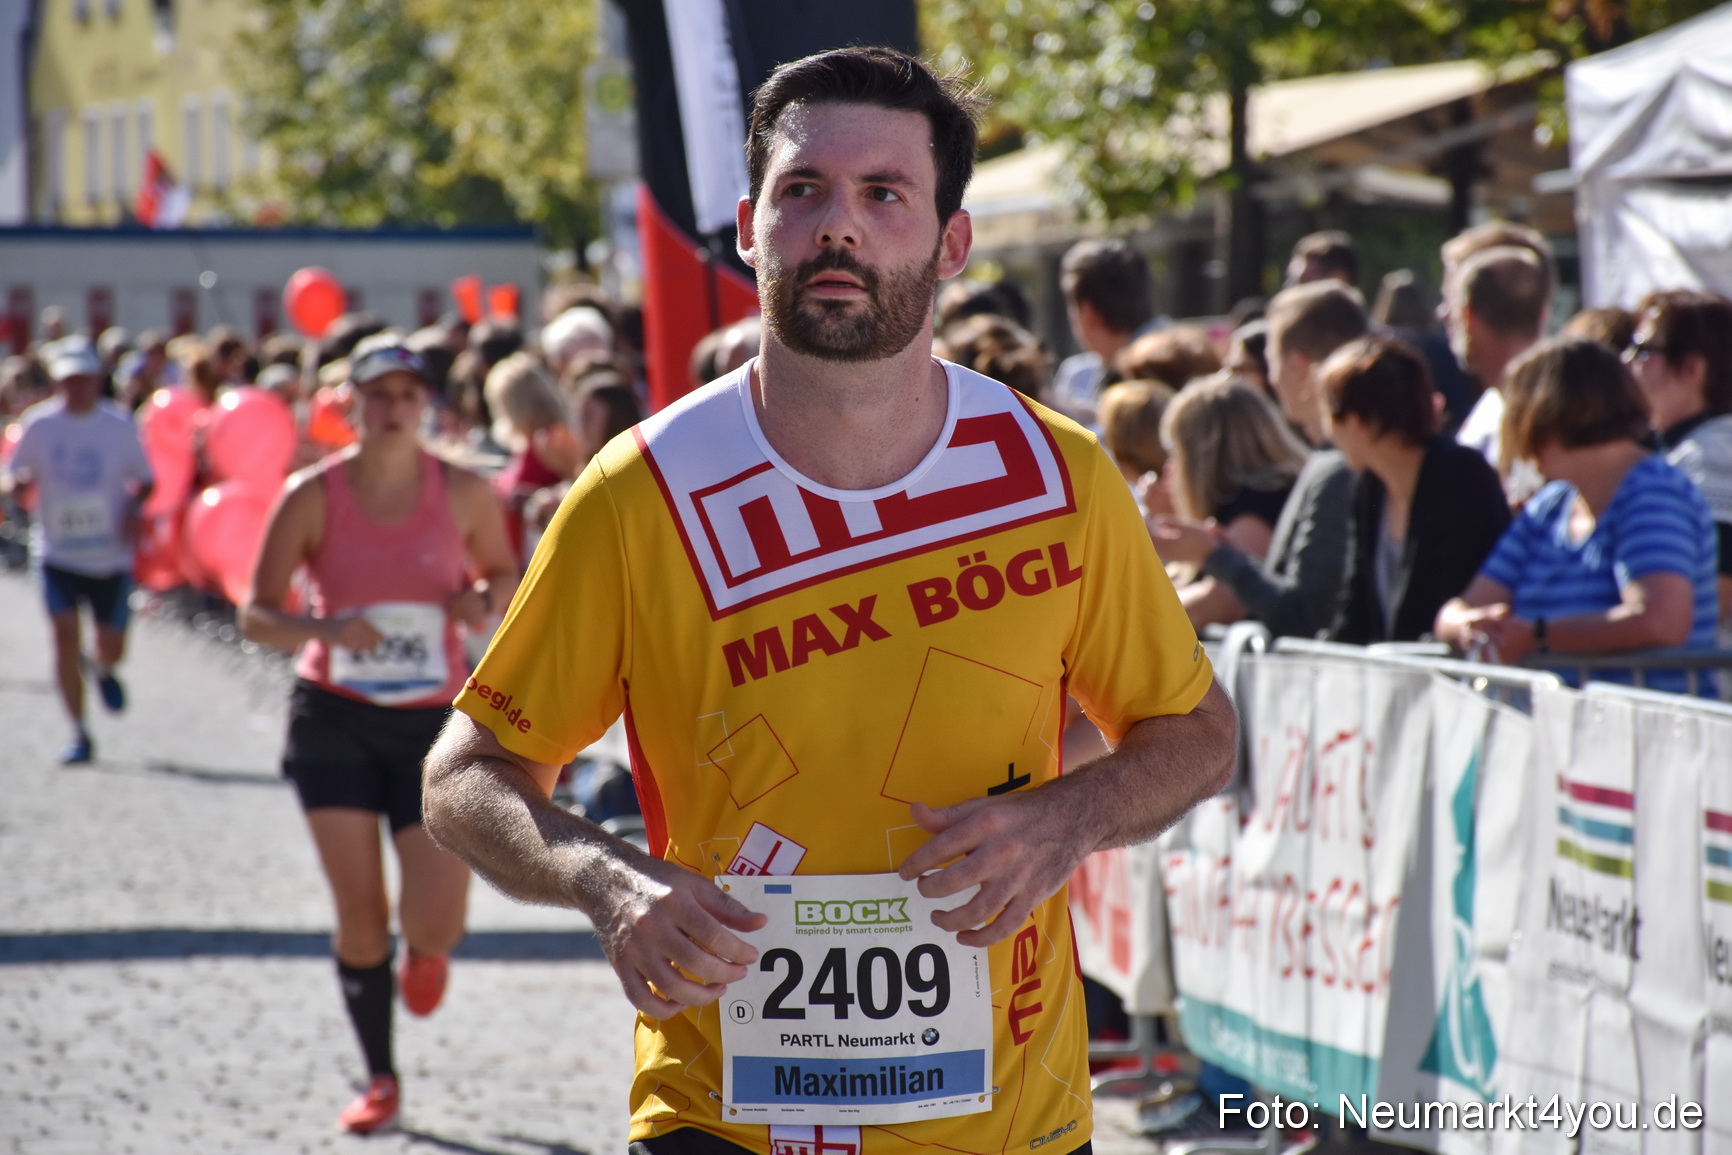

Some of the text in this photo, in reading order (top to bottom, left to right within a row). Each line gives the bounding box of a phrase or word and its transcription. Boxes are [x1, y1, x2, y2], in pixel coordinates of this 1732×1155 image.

[722, 541, 1082, 687] MAX BÖGL
[795, 897, 911, 925] BOCK
[795, 925, 913, 937] inspired by smart concepts
[759, 943, 951, 1020] 2409
[736, 1006, 746, 1019] D
[780, 1032, 915, 1048] PARTL Neumarkt
[774, 1065, 944, 1097] Maximilian
